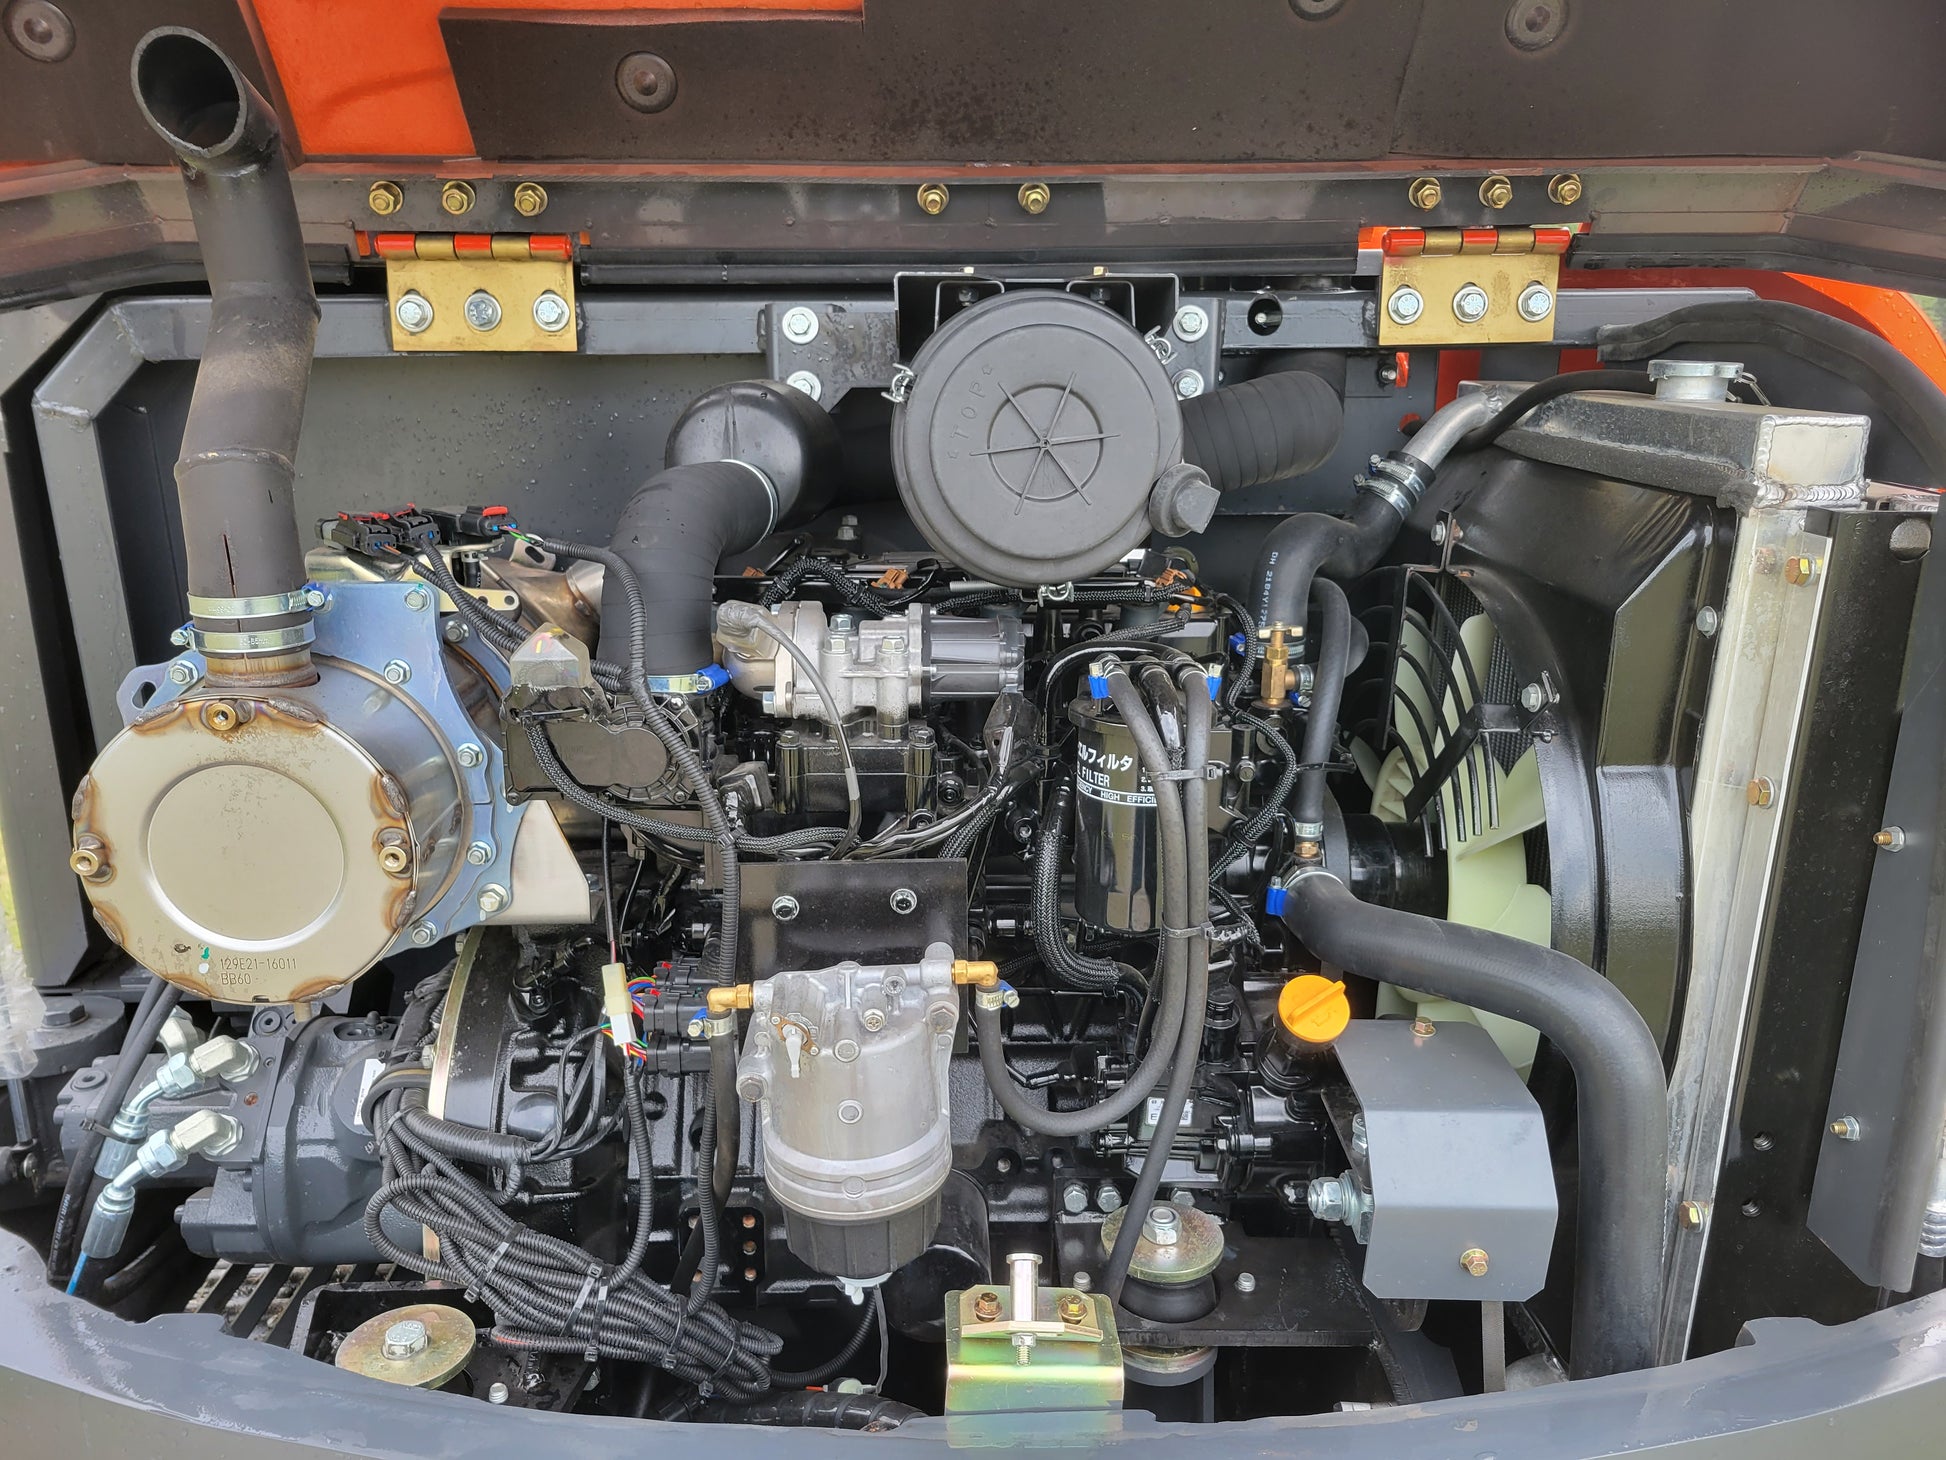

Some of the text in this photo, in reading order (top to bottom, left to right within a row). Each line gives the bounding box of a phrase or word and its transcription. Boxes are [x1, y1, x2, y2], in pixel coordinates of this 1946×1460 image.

[950, 381, 986, 440] TOP
[1269, 551, 1279, 565] DH
[1082, 768, 1110, 787] FILTER
[1100, 791, 1120, 801] HIGH
[220, 957, 297, 970] 129E21-16011
[221, 973, 251, 985] BB60
